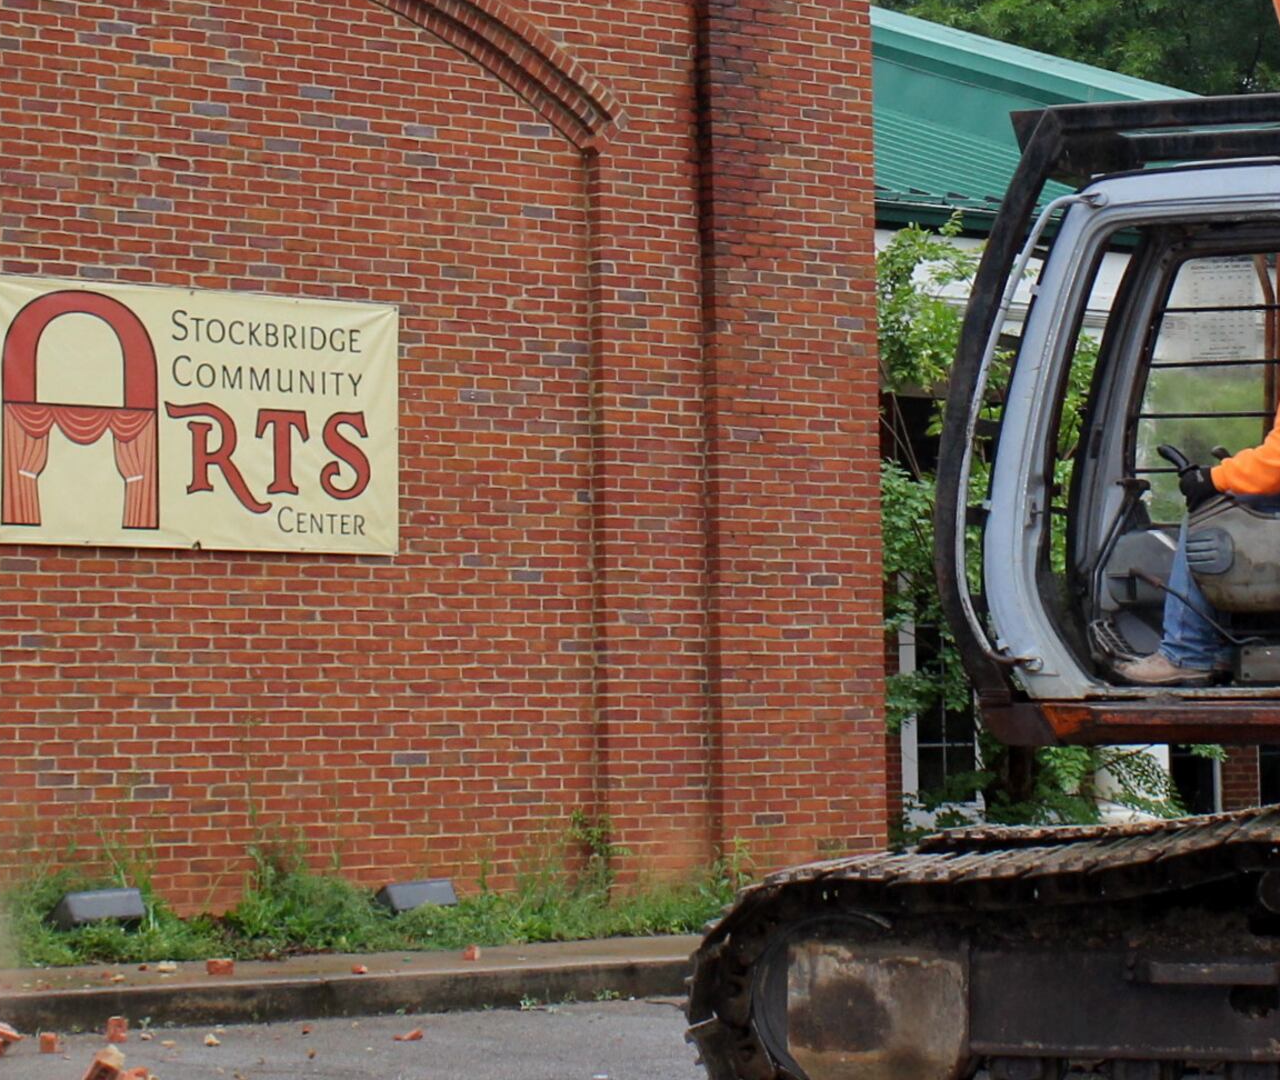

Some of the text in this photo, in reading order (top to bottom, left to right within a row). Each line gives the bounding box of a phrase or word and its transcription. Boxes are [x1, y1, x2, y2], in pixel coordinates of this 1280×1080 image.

[171, 309, 363, 353] STOCKBRIDGE
[171, 354, 364, 397] COMMUNITY
[277, 506, 367, 536] CENTER
